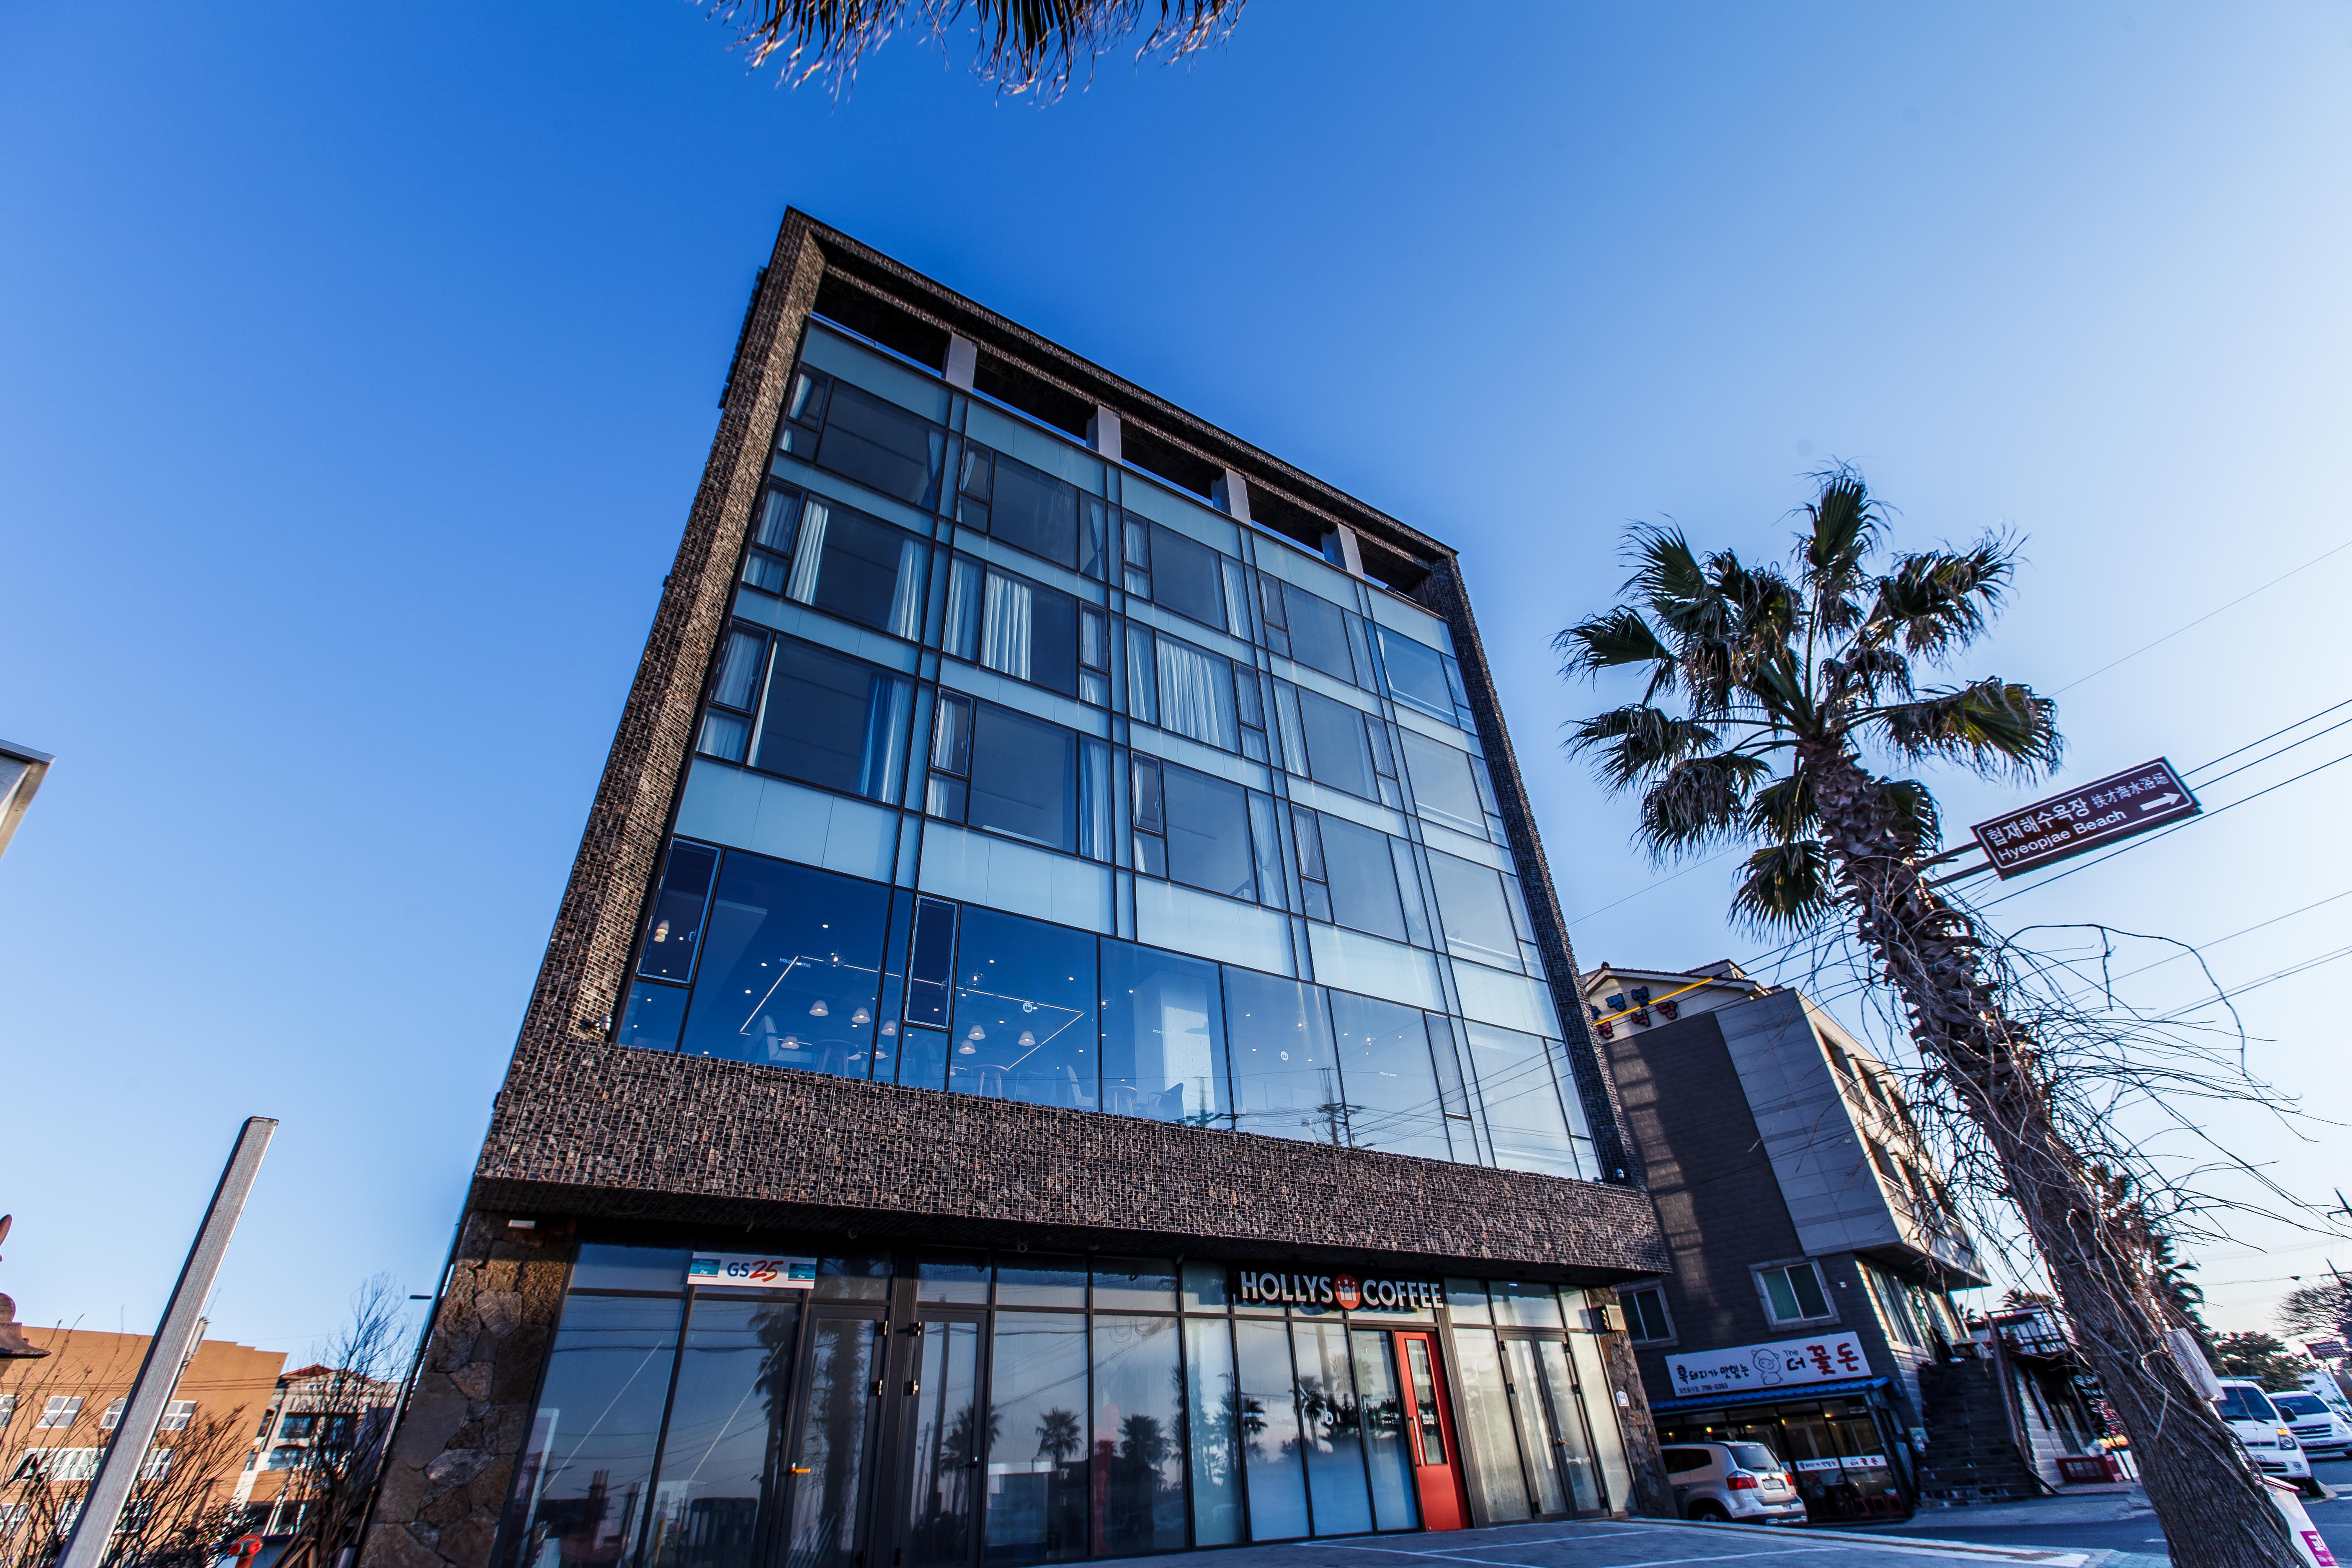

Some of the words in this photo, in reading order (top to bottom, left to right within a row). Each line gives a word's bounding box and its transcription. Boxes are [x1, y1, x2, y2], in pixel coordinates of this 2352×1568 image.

[1986, 797, 2090, 846] 협재해수욕장
[1997, 830, 2071, 861] Hyeopjae
[2073, 811, 2127, 834] Beach
[727, 1260, 784, 1282] GS25
[1240, 1271, 1333, 1303] HOLLYS
[1362, 1280, 1444, 1309] COFFEE
